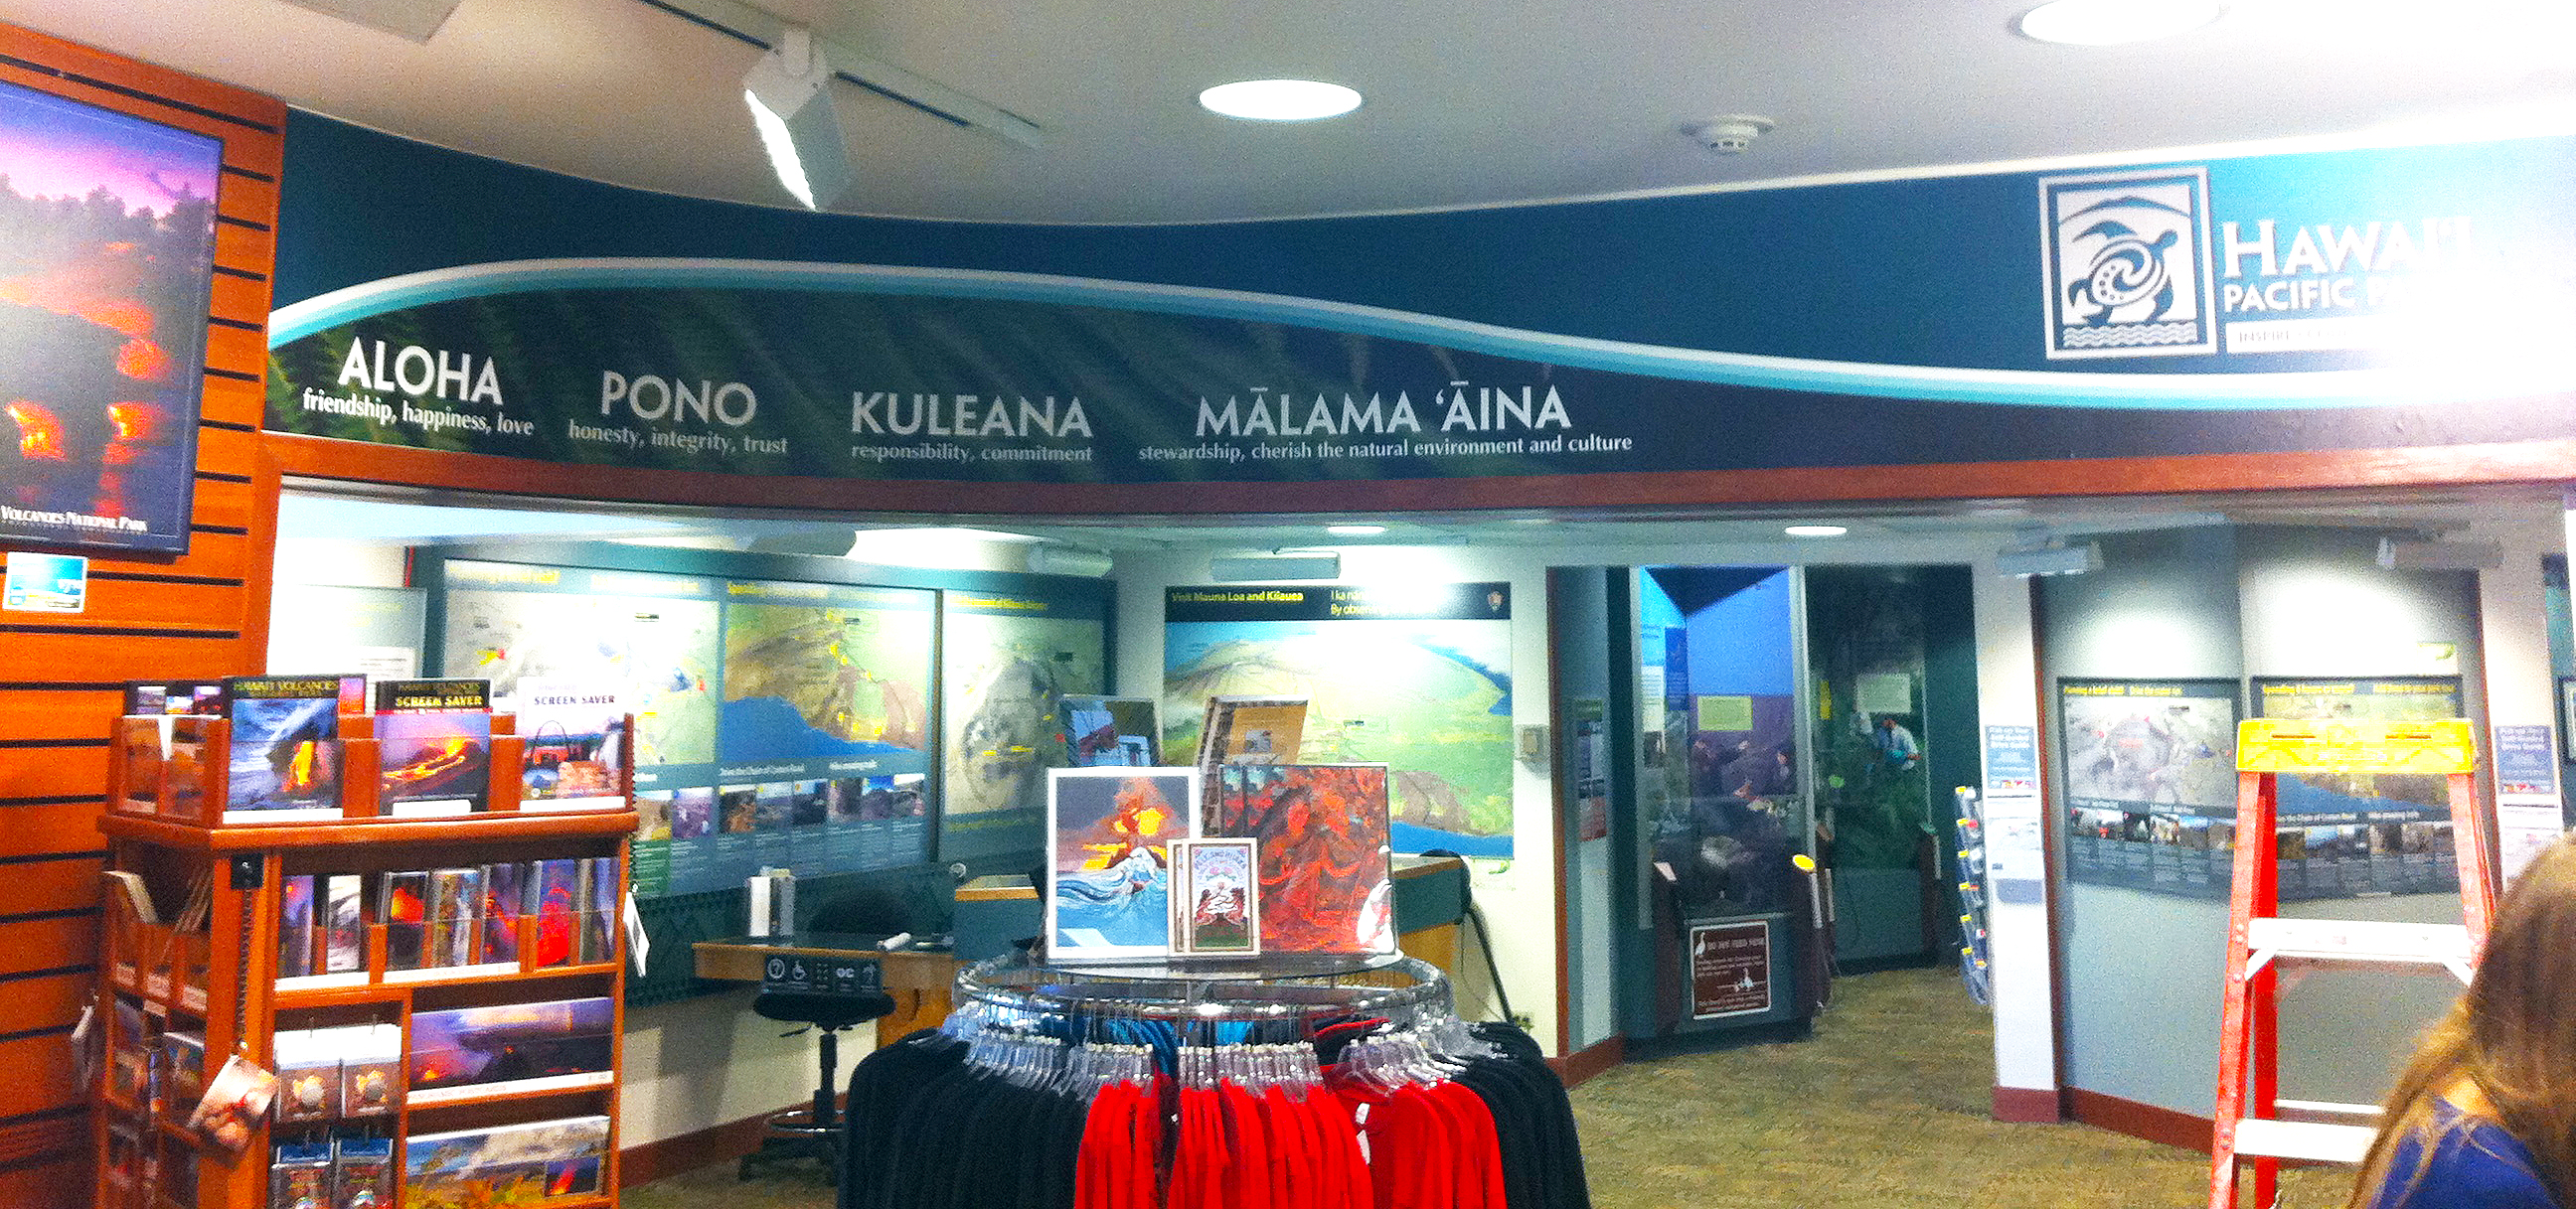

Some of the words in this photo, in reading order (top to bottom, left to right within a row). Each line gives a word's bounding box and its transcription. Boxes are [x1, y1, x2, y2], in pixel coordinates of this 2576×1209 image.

[2223, 277, 2357, 313] PACIFIC
[339, 336, 504, 406] ALOHA
[301, 386, 399, 423] friendship,
[402, 399, 493, 434] happiness,
[497, 412, 536, 436] love
[601, 370, 758, 427] PONO
[850, 391, 1094, 438] KULEANA
[1196, 385, 1422, 438] MĀLAMA
[568, 418, 646, 449] honesty,
[651, 425, 737, 456] integrity,
[743, 434, 788, 454] trust
[851, 441, 974, 463] responsibility,
[980, 443, 1093, 462] commitment
[1138, 442, 1246, 463] stewardship,
[1250, 440, 1312, 460] cherish
[1317, 440, 1346, 459] the
[1349, 439, 1409, 458] natural
[1414, 436, 1525, 456] environment
[1529, 434, 1563, 454] and
[1567, 432, 1633, 452] culture
[1228, 592, 1245, 602] Loa
[1247, 590, 1266, 602] and
[395, 695, 442, 707] SCREEN
[444, 695, 484, 707] SAVER
[534, 695, 577, 705] SCREEN
[581, 694, 615, 704] SAVER
